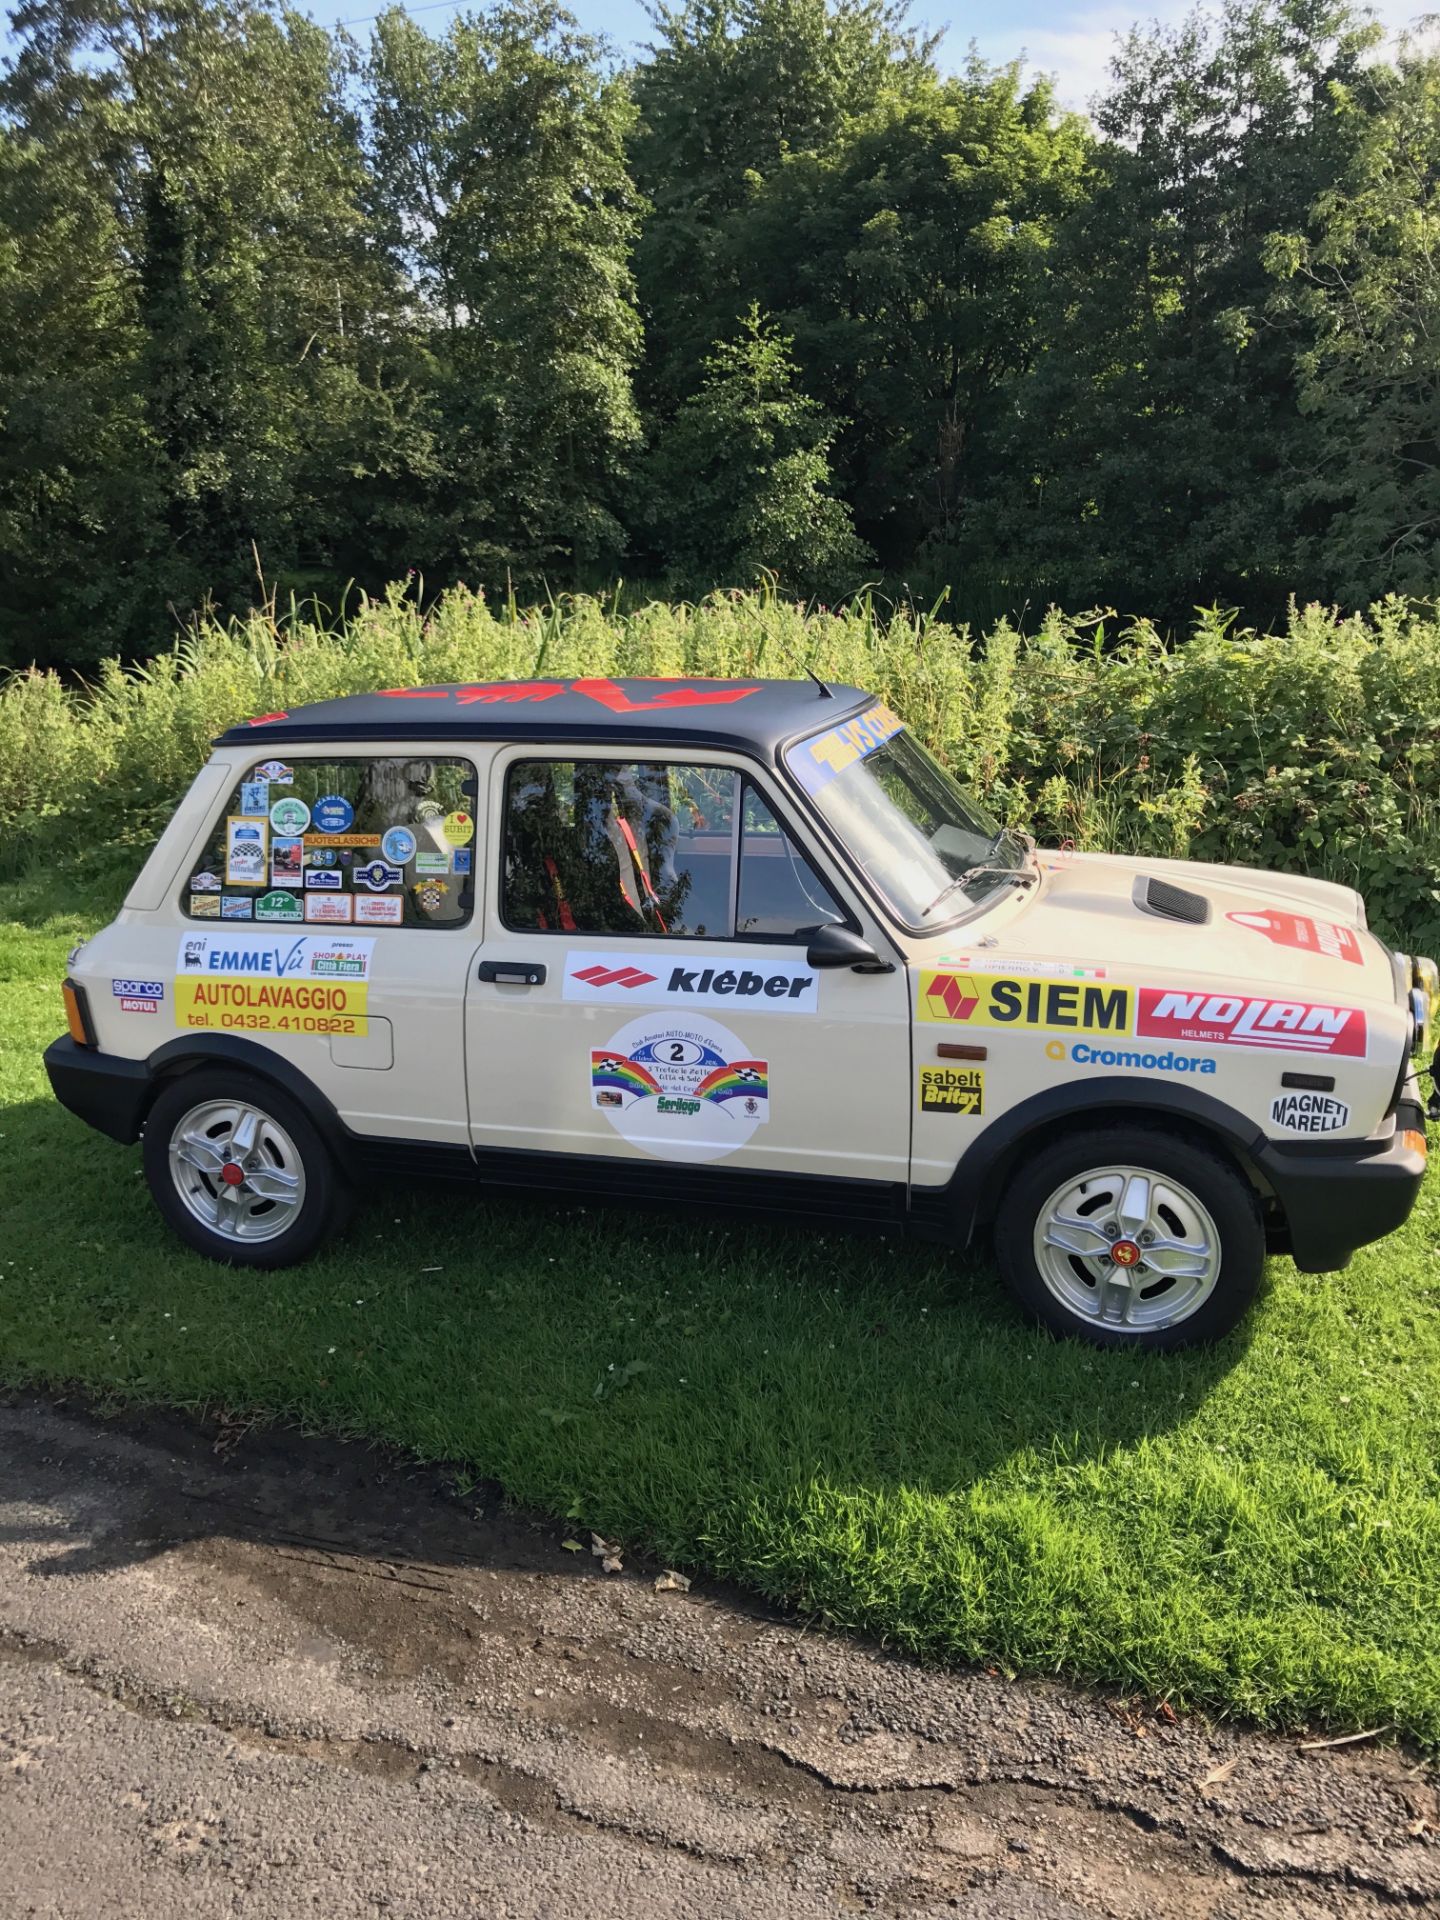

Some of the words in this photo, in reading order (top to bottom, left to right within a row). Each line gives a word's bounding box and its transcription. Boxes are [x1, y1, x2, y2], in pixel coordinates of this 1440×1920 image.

[185, 938, 207, 952] eni
[113, 980, 163, 994] sparco
[667, 967, 813, 998] kléber
[123, 1001, 156, 1012] MOTUL
[193, 983, 347, 1011] AUTOLAVAGGIO
[988, 980, 1128, 1031] SIEM
[187, 1013, 214, 1027] tel.
[221, 1014, 356, 1034] 0432.410822
[1151, 993, 1354, 1040] NOLAN
[1181, 1029, 1225, 1040] HELMETS
[670, 1043, 684, 1061] 2
[1071, 1044, 1216, 1074] Cromodora
[922, 1070, 981, 1086] sabelt
[925, 1085, 980, 1109] Britax
[1272, 1094, 1348, 1122] MAGNETI
[1272, 1104, 1347, 1132] MARELLI
